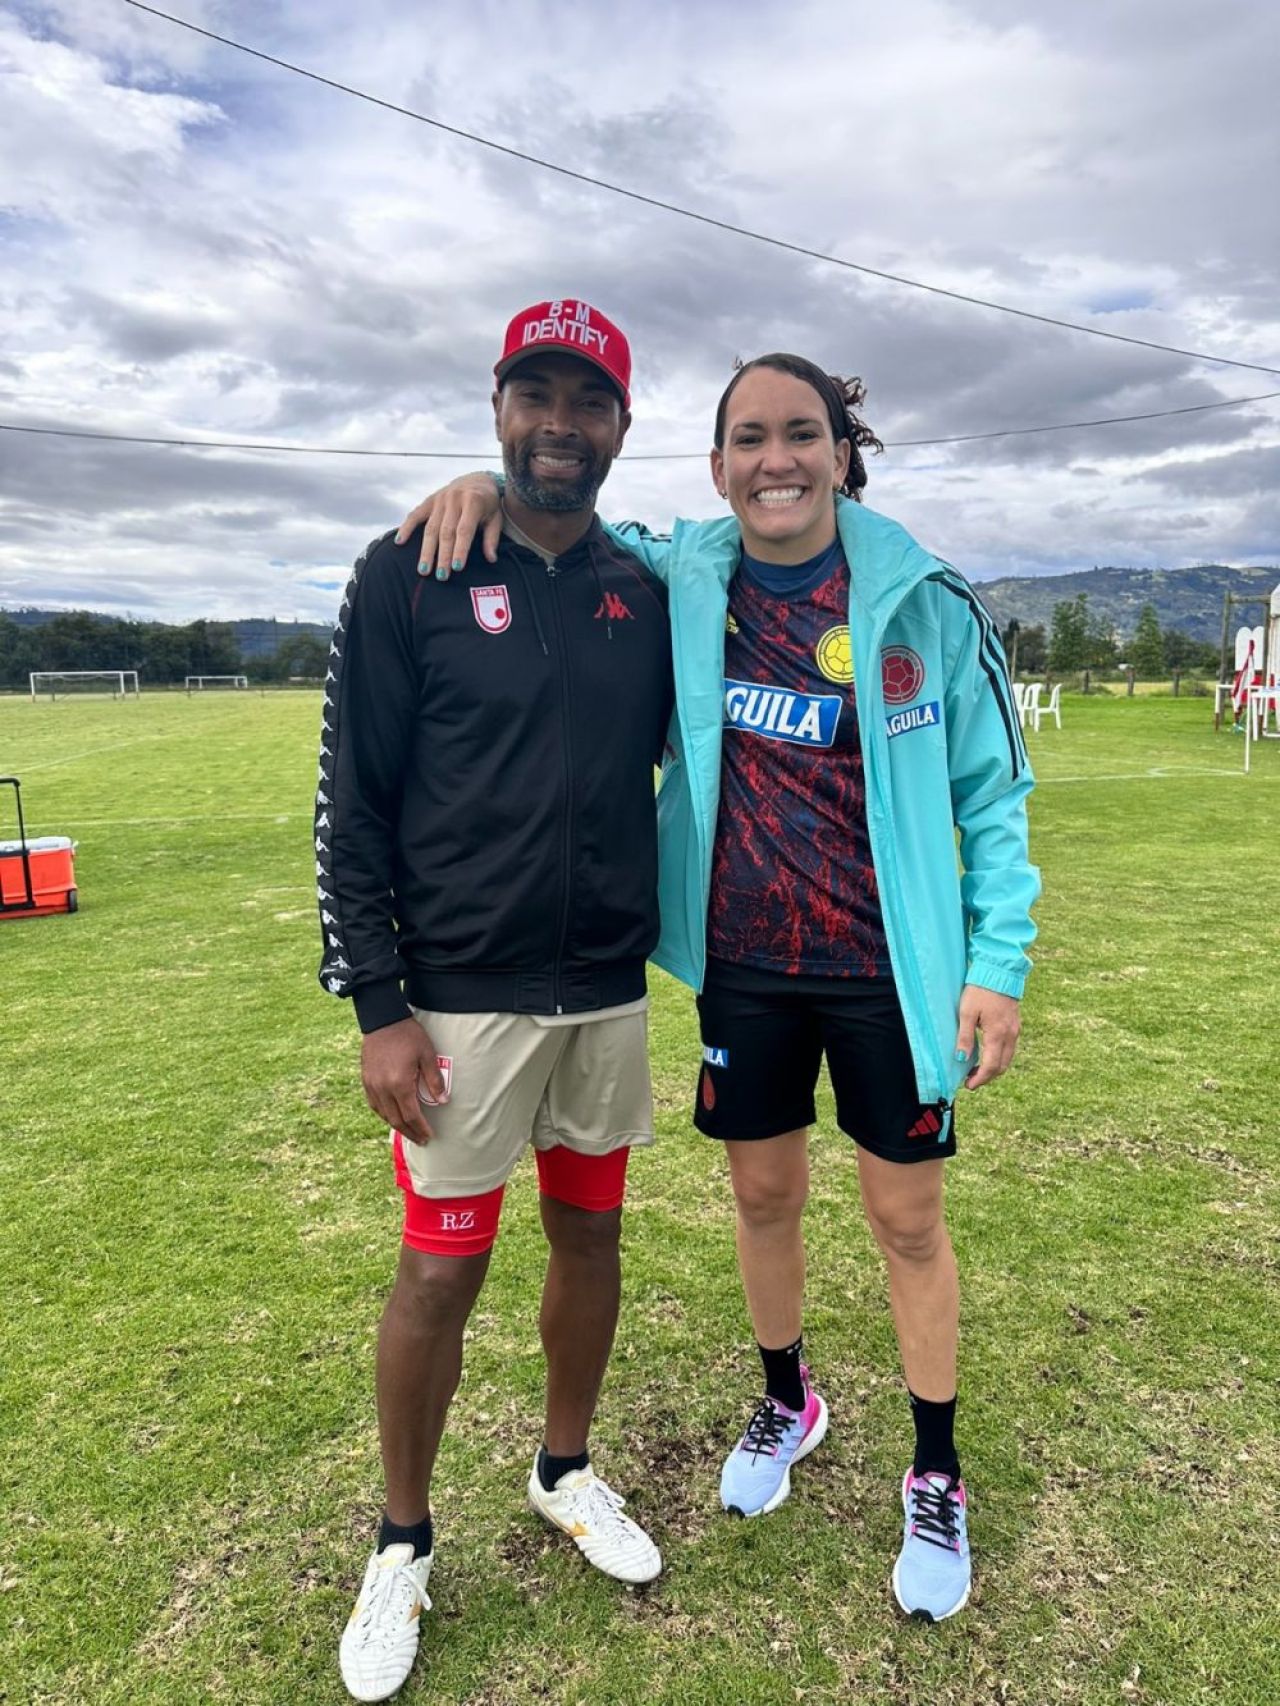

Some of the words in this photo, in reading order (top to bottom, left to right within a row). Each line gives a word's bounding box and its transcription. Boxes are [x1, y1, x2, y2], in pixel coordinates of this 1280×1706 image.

[522, 317, 609, 355] IDENTIFY
[475, 589, 495, 597] SANTA
[726, 687, 823, 742] GUILA
